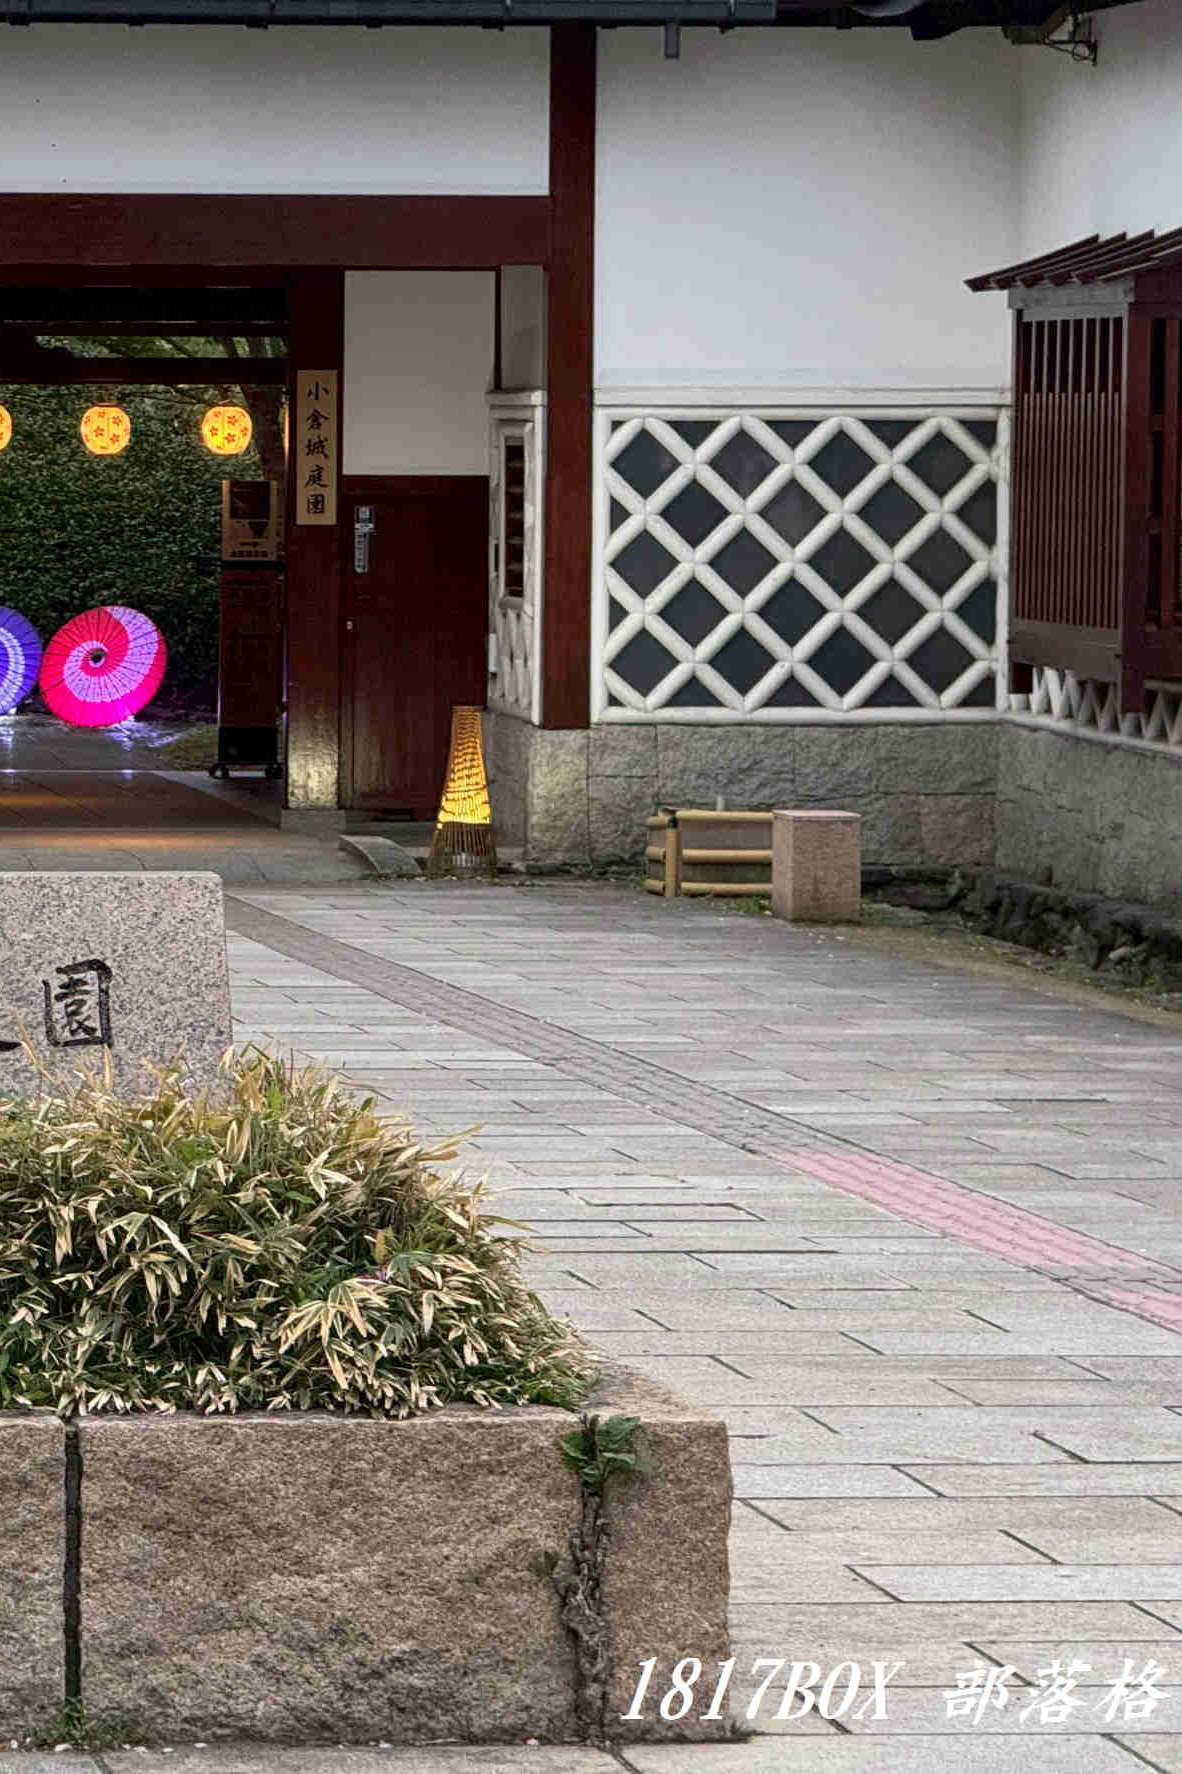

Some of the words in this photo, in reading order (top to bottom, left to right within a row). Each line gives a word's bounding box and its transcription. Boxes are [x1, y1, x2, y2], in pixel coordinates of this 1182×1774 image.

[305, 380, 330, 514] 小倉城庭園
